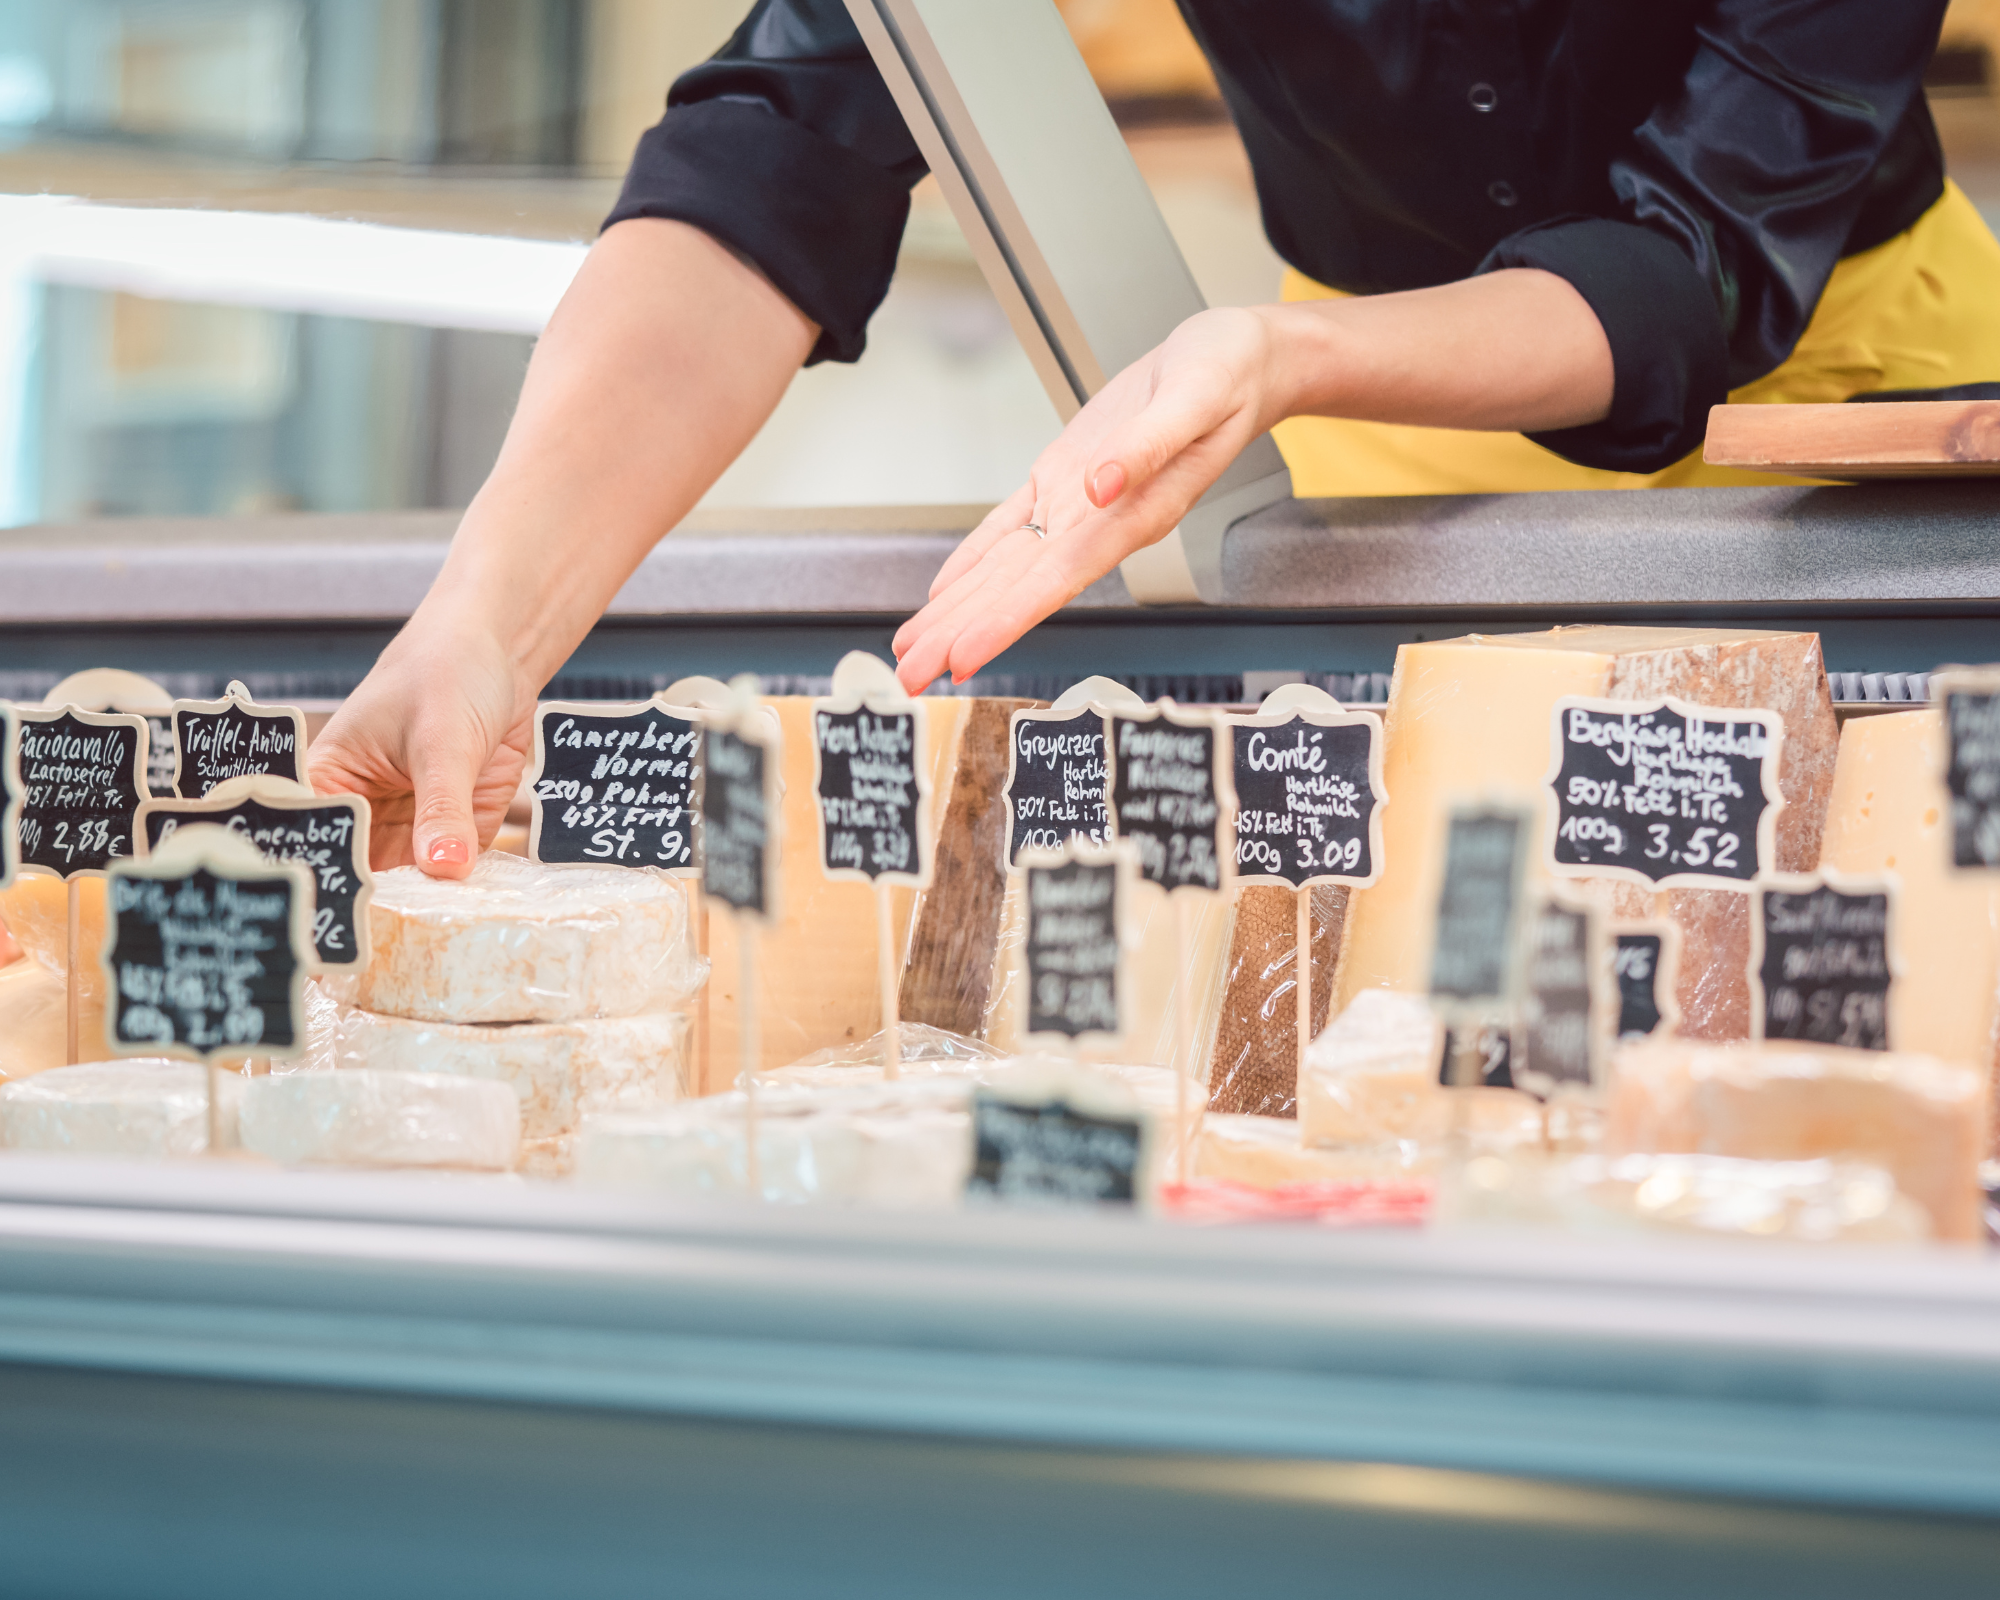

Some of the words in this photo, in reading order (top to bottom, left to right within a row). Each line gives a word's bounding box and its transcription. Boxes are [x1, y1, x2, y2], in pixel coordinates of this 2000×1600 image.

[17, 725, 125, 767] Caciocavallo
[1017, 721, 1104, 770] Greyerzer
[1247, 729, 1327, 773] Comté
[1568, 709, 1683, 766] Bergkäse
[29, 761, 117, 787] Lactosefrei
[1285, 775, 1361, 801] Hartkäse
[1634, 766, 1744, 798] Rohmilch
[54, 784, 89, 809] Fett
[537, 779, 594, 805] 250g
[1285, 792, 1361, 819] Rohmilch
[1566, 776, 1621, 808] 50%
[1621, 785, 1677, 816] Fett
[561, 805, 617, 829] 45%
[1017, 796, 1046, 820] 50%
[1049, 799, 1080, 822] Fett
[1231, 808, 1263, 834] 45%
[1264, 812, 1293, 835] Fett
[582, 827, 641, 860] St.
[1020, 828, 1064, 854] 100g
[1230, 838, 1282, 873] 100g
[1296, 837, 1362, 870] 3.09
[1559, 815, 1624, 855] 100g
[1643, 823, 1740, 868] 3,52
